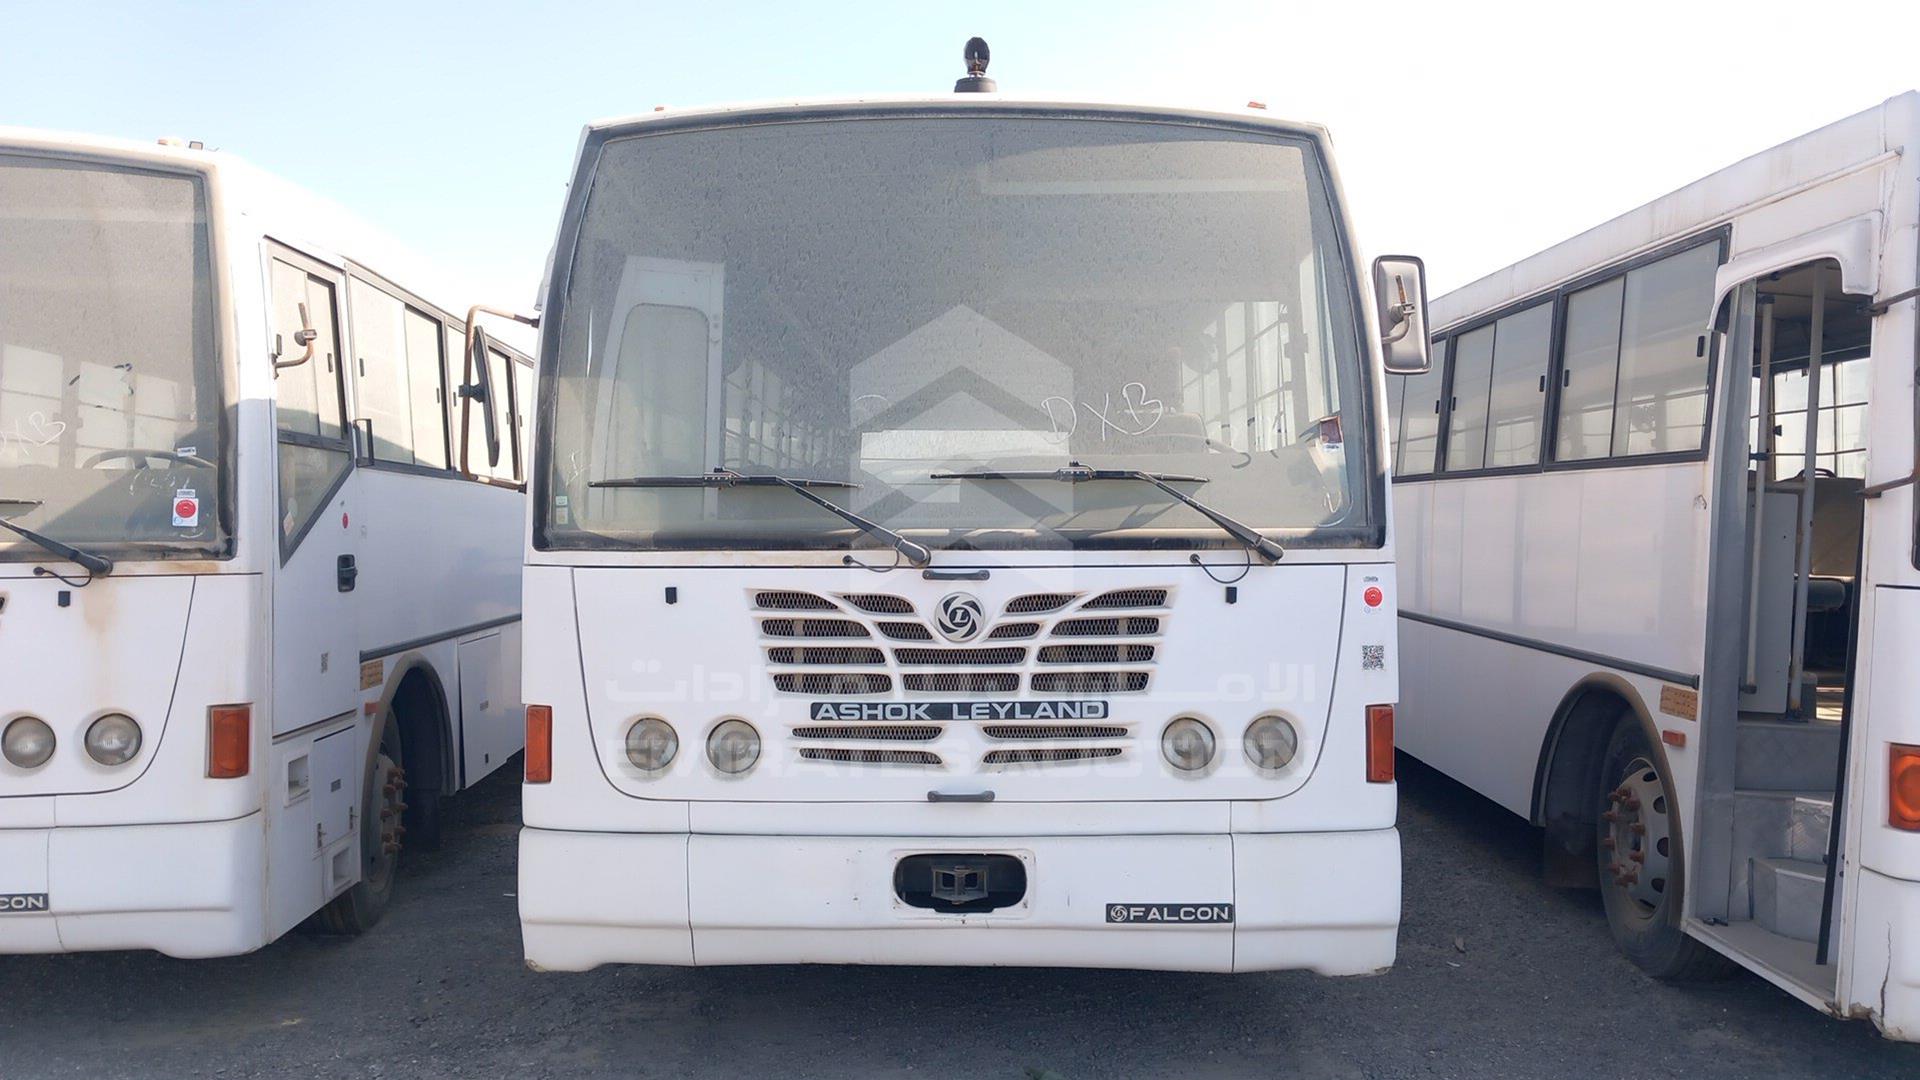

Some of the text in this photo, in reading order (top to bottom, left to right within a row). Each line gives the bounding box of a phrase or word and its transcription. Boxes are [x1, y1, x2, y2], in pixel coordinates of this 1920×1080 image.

[1041, 382, 1163, 445] DXB
[814, 702, 1106, 720] ASHOK LEYLAND
[1129, 906, 1229, 921] FALCON
